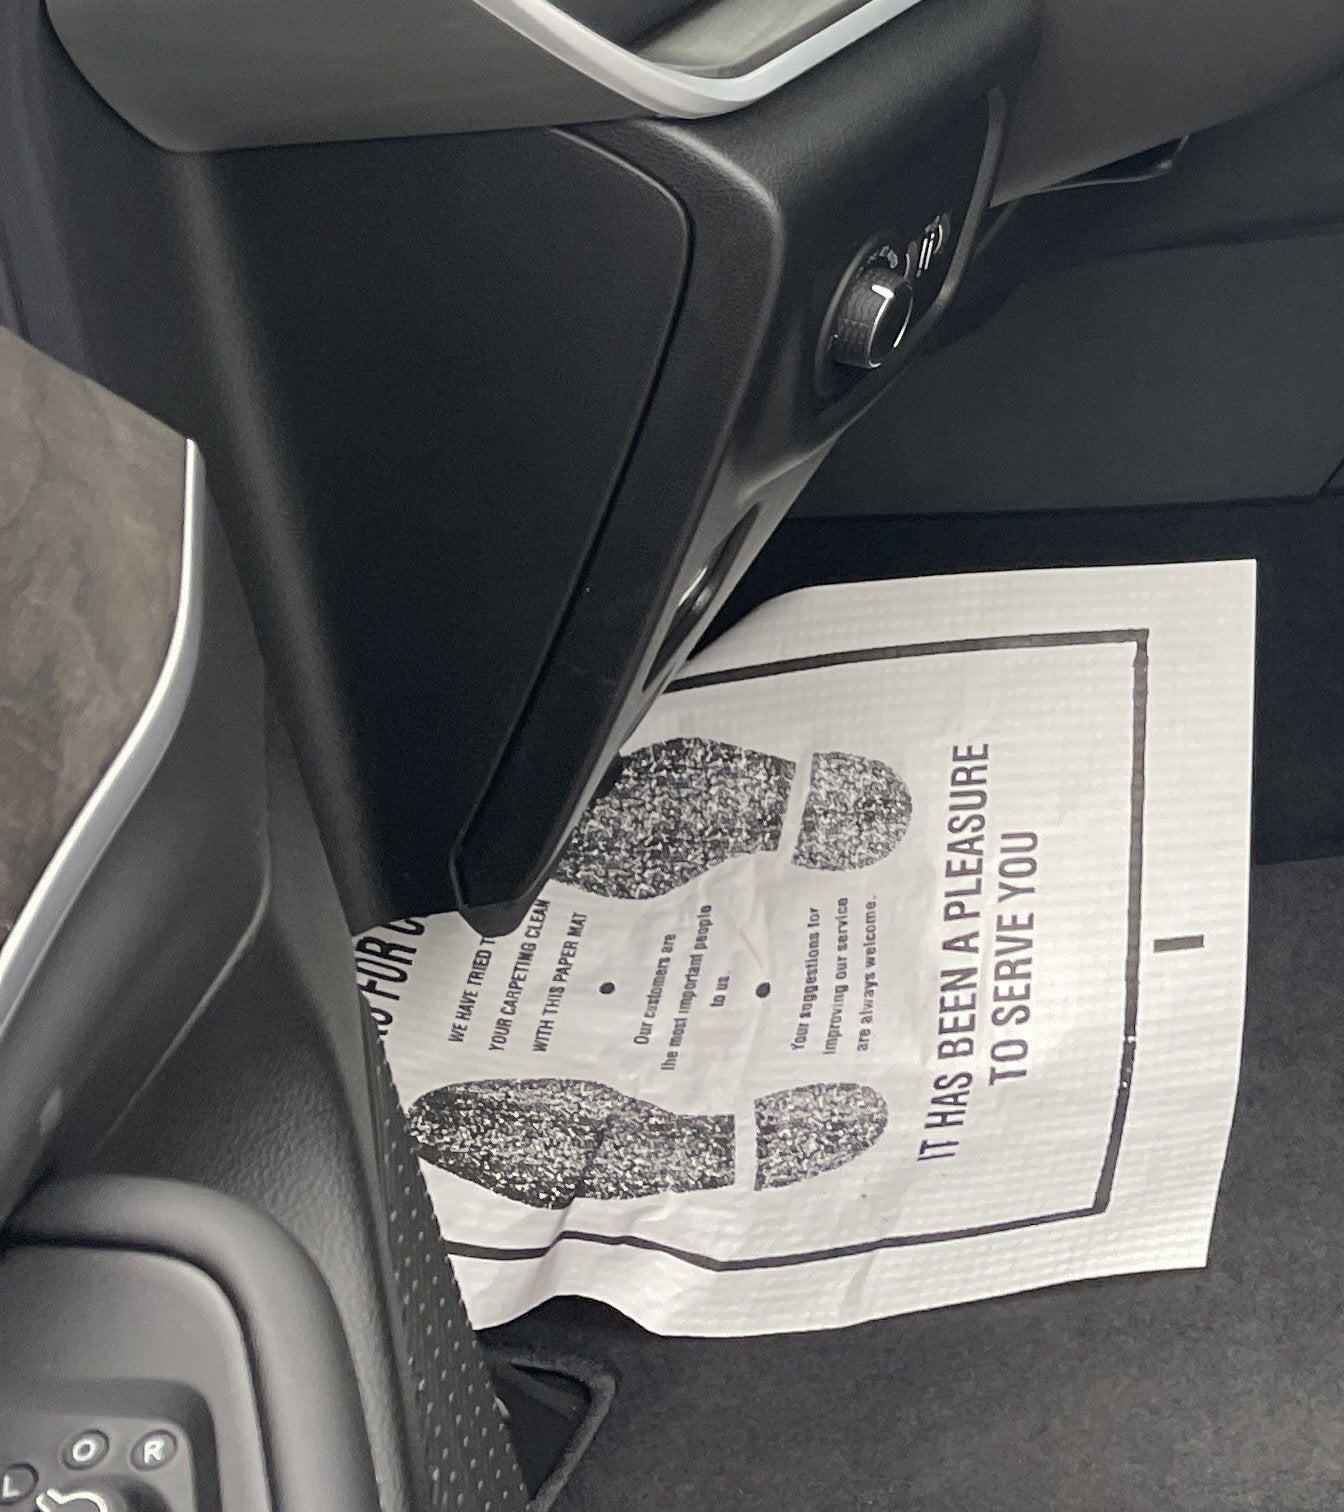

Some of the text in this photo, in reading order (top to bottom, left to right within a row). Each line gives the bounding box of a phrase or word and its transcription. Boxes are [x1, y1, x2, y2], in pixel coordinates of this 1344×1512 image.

[694, 905, 713, 950] people
[835, 897, 849, 951] service
[467, 949, 492, 986] TRIED
[835, 955, 848, 980] our
[917, 742, 989, 1162] IT HAS BEEN A PLEASURE
[988, 830, 1038, 1086] TO SERVE YOU
[489, 899, 550, 1051] YOUR CARPETING CLEAN
[533, 912, 587, 1052] WITH THIS PAPER MAT
[633, 934, 676, 1045] Our customers are
[799, 932, 821, 1019] suggestions
[456, 989, 479, 1020] HAVE
[859, 972, 879, 1024] always
[448, 1023, 467, 1042] WE
[791, 1023, 809, 1051] Your
[857, 1028, 871, 1052] are
[143, 1439, 165, 1464] R
[2, 1473, 21, 1498] L
